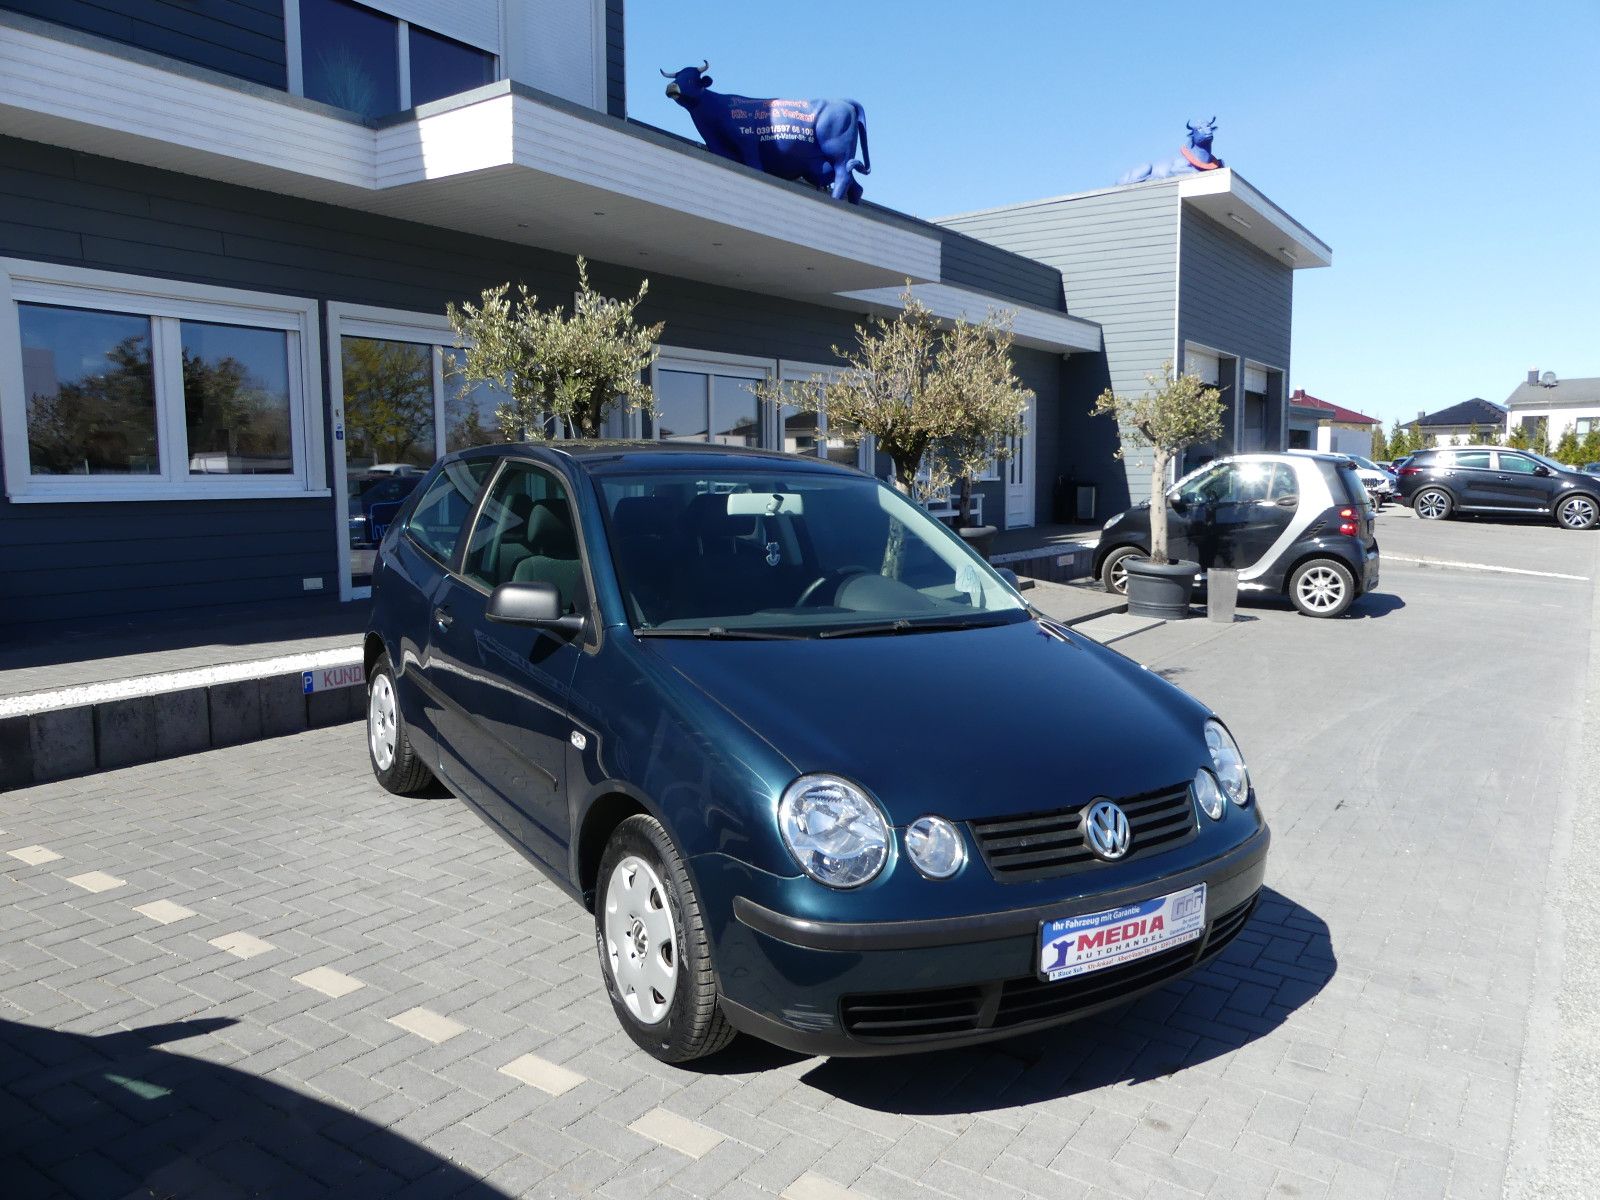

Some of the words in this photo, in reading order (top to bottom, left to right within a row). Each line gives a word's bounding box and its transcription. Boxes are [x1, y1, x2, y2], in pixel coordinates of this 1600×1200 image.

[304, 676, 312, 689] P
[324, 666, 364, 687] KUND
[1053, 921, 1064, 931] Ihr
[1065, 914, 1100, 929] Fahrzeug
[1100, 913, 1112, 924] mit
[1113, 906, 1141, 919] Garantie
[1076, 932, 1163, 961] AUTOHANDEL
[1077, 914, 1164, 952] MEDIA
